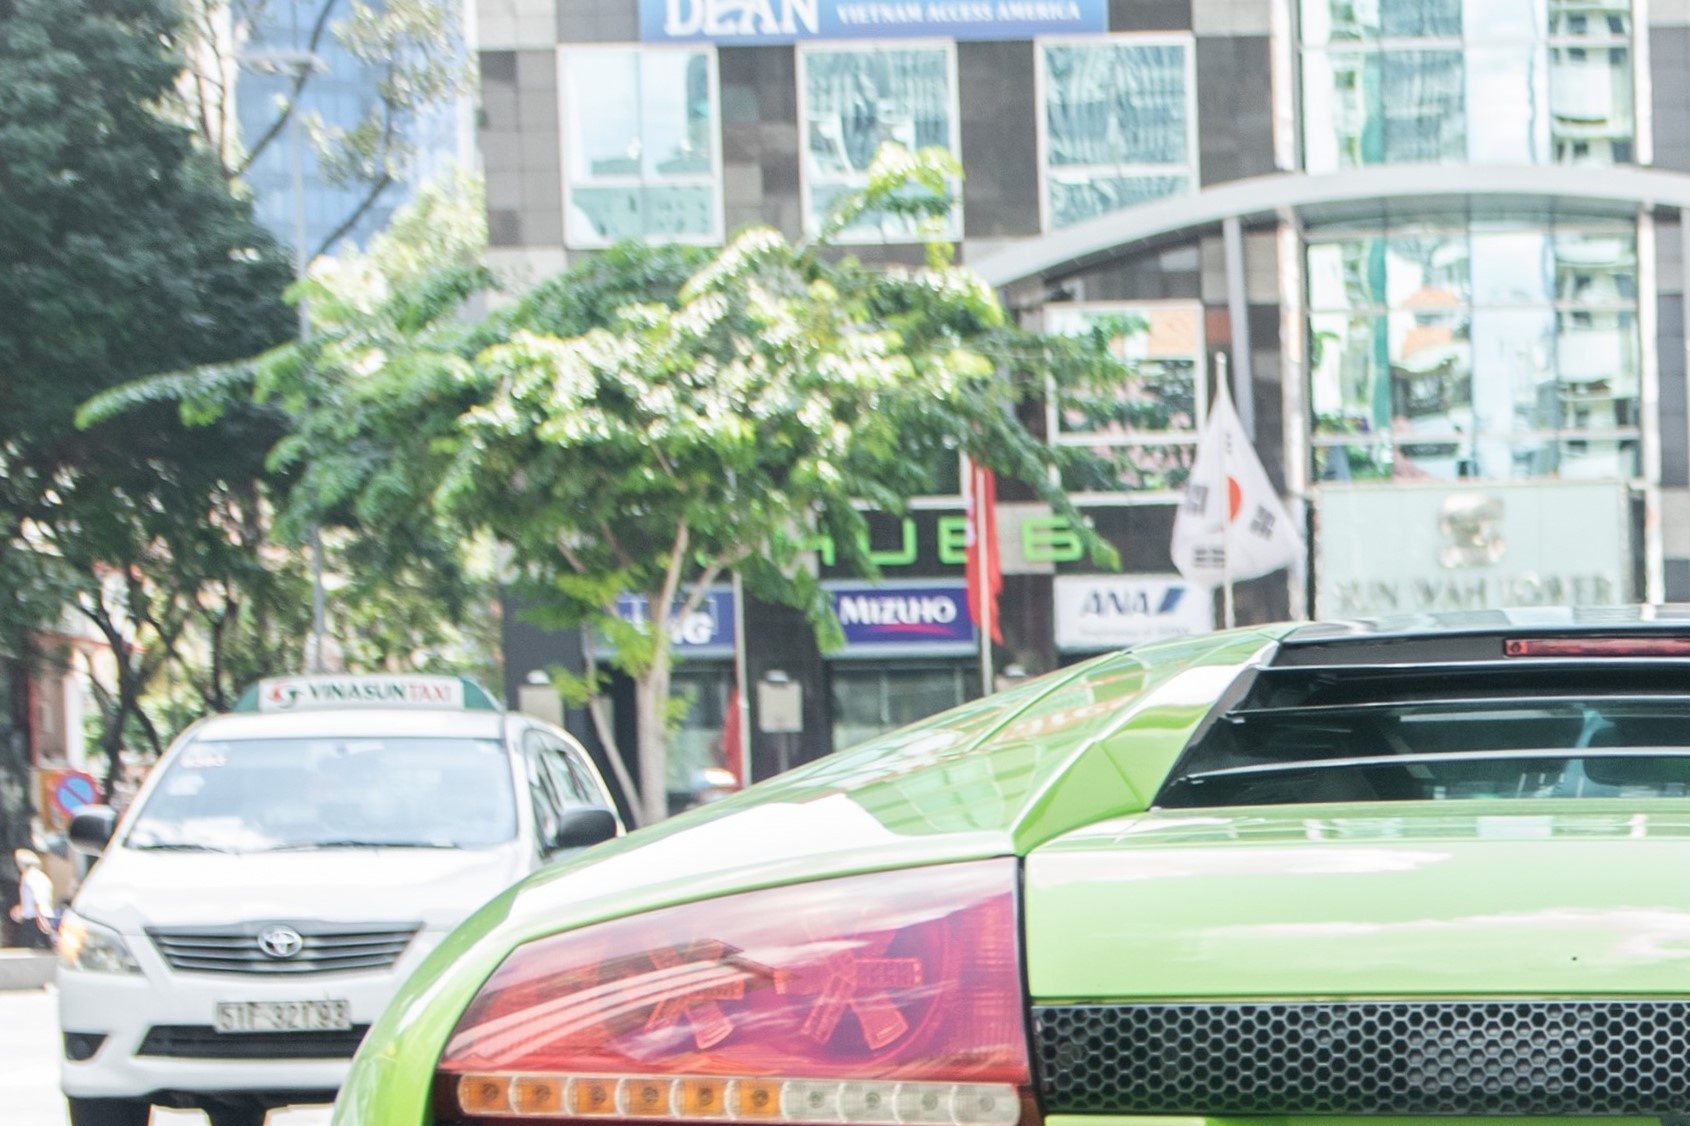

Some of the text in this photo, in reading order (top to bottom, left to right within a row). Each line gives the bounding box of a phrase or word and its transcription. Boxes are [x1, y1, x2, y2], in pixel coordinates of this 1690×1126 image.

[836, 1, 1081, 24] VIETNAM ACCESS AMERICA
[839, 596, 957, 625] MIZUHO
